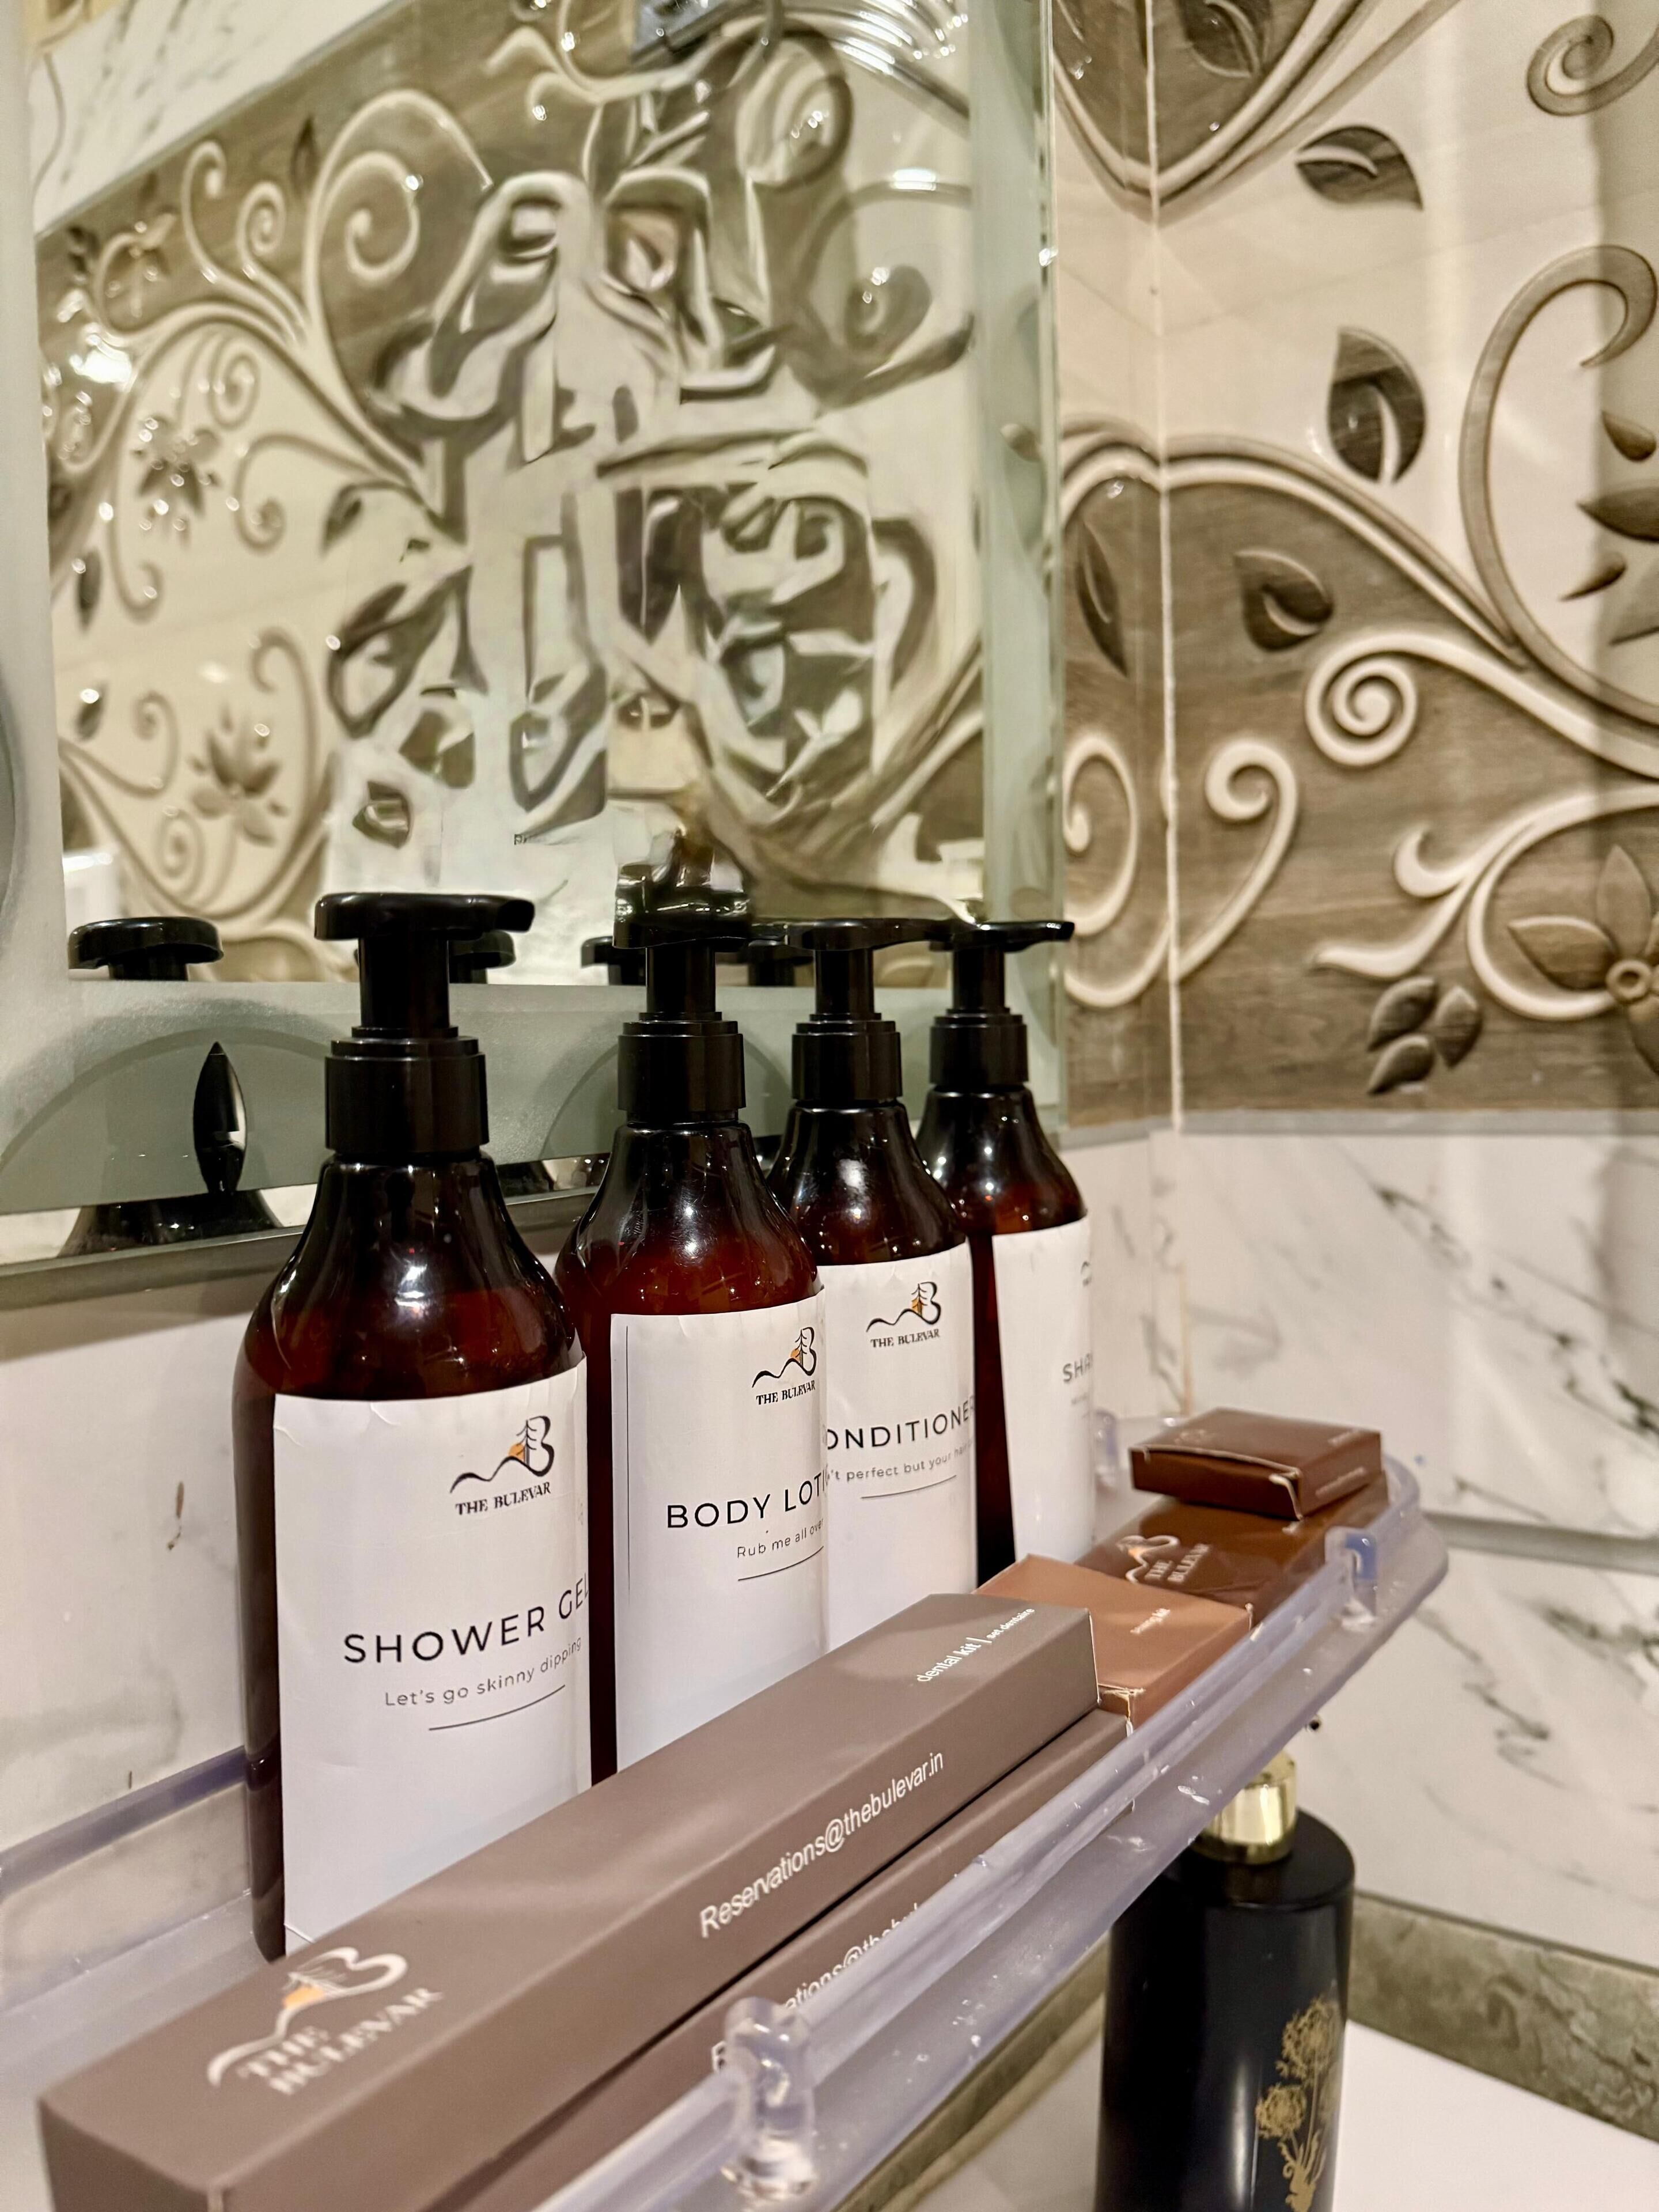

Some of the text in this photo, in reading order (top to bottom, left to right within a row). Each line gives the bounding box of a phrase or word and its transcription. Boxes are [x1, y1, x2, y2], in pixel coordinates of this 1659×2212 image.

[870, 1328, 940, 1348] THE BULEVAR
[756, 1380, 816, 1405] THE BULEVAR
[847, 1466, 898, 1482] perfect
[904, 1460, 925, 1474] but
[929, 1452, 951, 1470] your
[455, 1482, 552, 1515] THE BULEVAR
[667, 1494, 771, 1528] BODY
[737, 1543, 766, 1558] Rub
[772, 1536, 791, 1551] me
[795, 1527, 807, 1543] all
[344, 1573, 589, 1664] SHOWER GEL
[917, 1608, 1035, 1682] dental kit set dentaire
[385, 1637, 582, 1706] Let's go skinny dipping
[699, 1750, 944, 1939] Reservations@thebulevar.in
